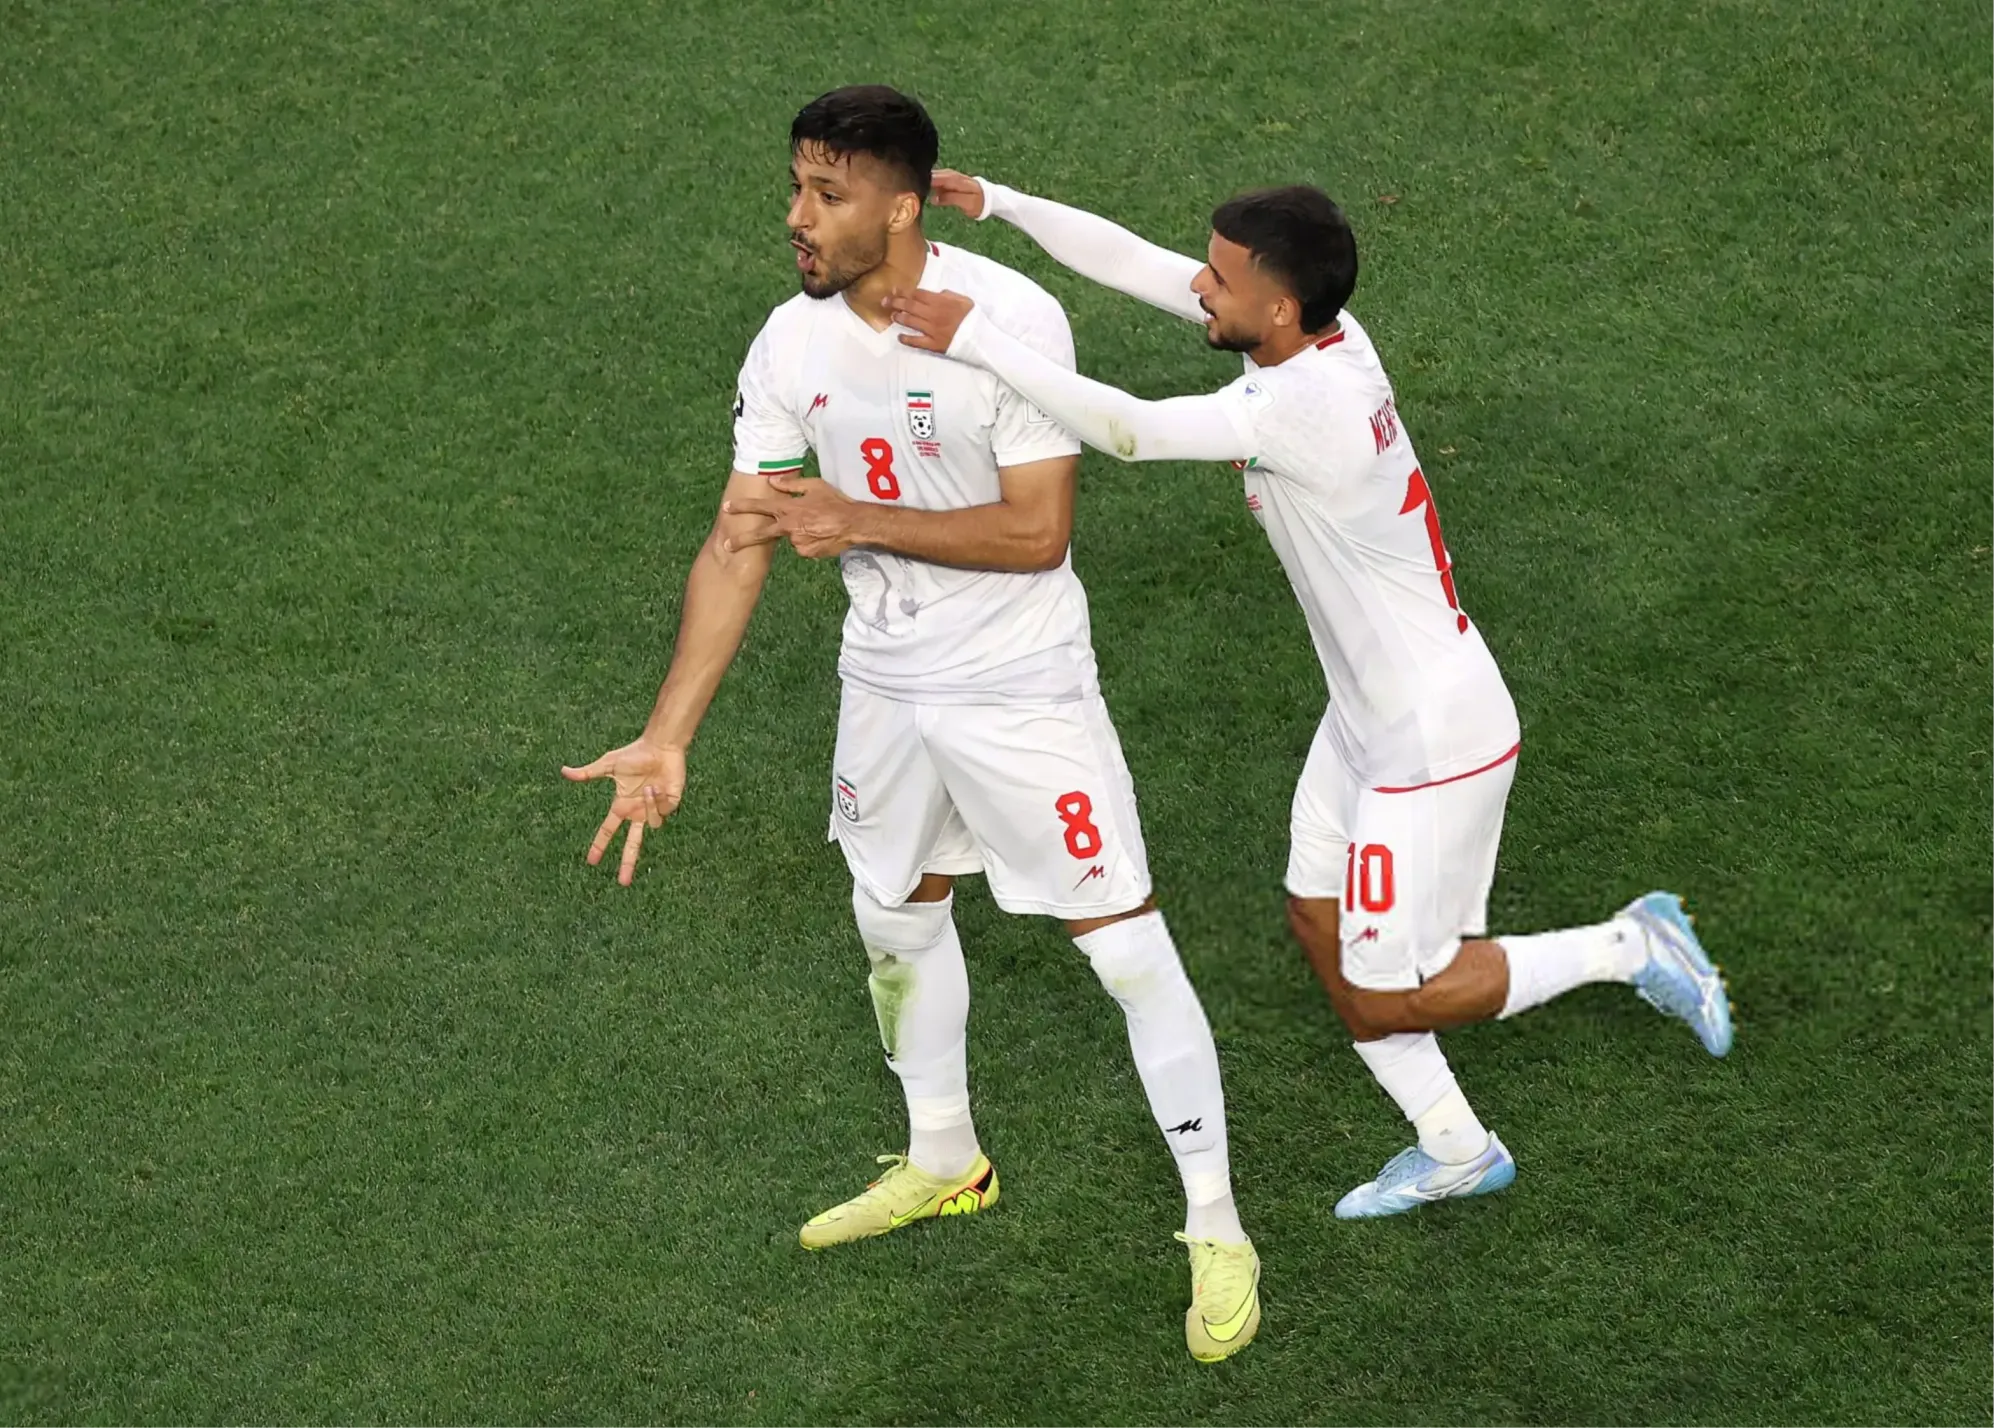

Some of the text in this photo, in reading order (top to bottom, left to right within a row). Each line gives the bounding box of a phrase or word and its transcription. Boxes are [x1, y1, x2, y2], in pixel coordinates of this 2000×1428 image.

[860, 437, 902, 501] 8
[1055, 790, 1103, 860] 8
[1345, 841, 1395, 913] 10
